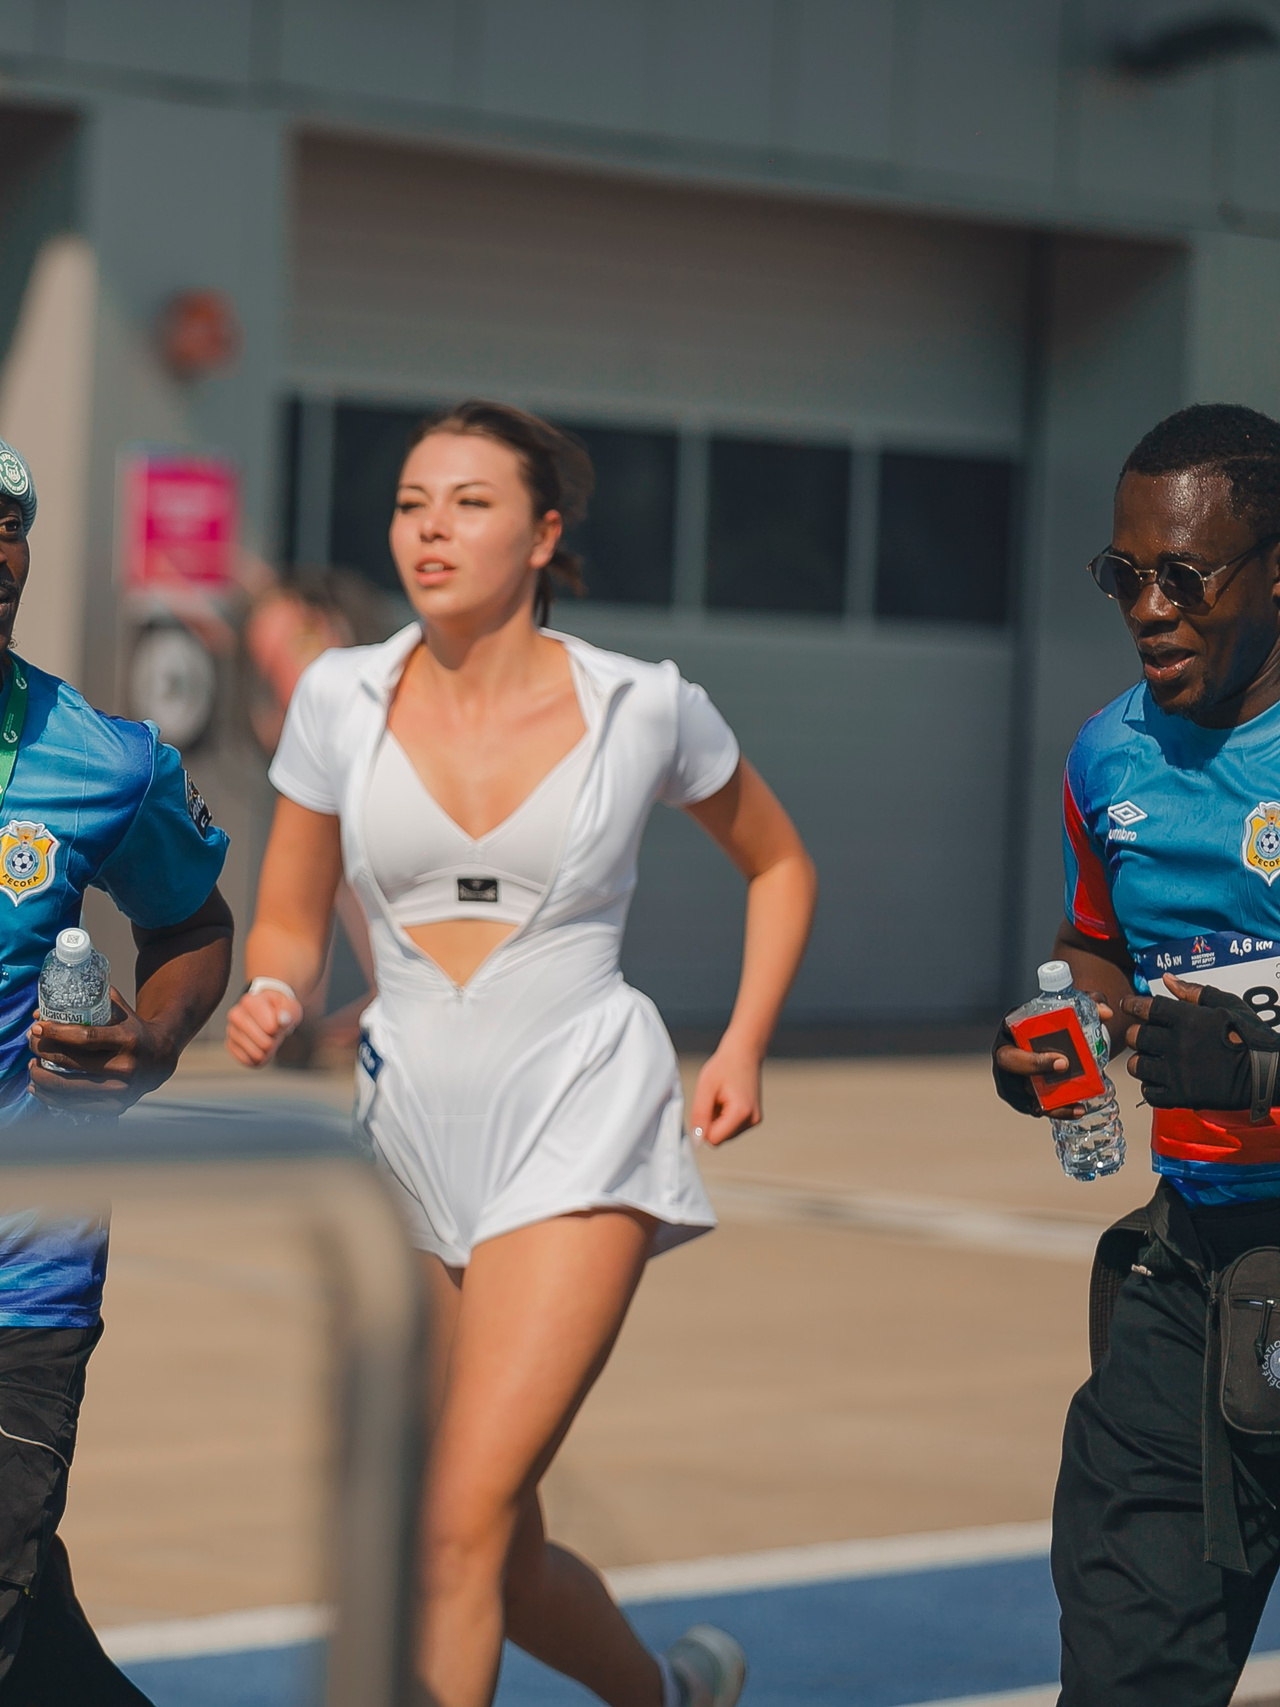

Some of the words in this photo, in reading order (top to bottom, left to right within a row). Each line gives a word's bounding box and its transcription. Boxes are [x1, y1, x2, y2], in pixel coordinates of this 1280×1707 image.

[1108, 828, 1137, 842] umbro
[2, 873, 39, 887] FECOFA
[1229, 937, 1252, 956] 4,6
[1156, 952, 1172, 971] 4,6
